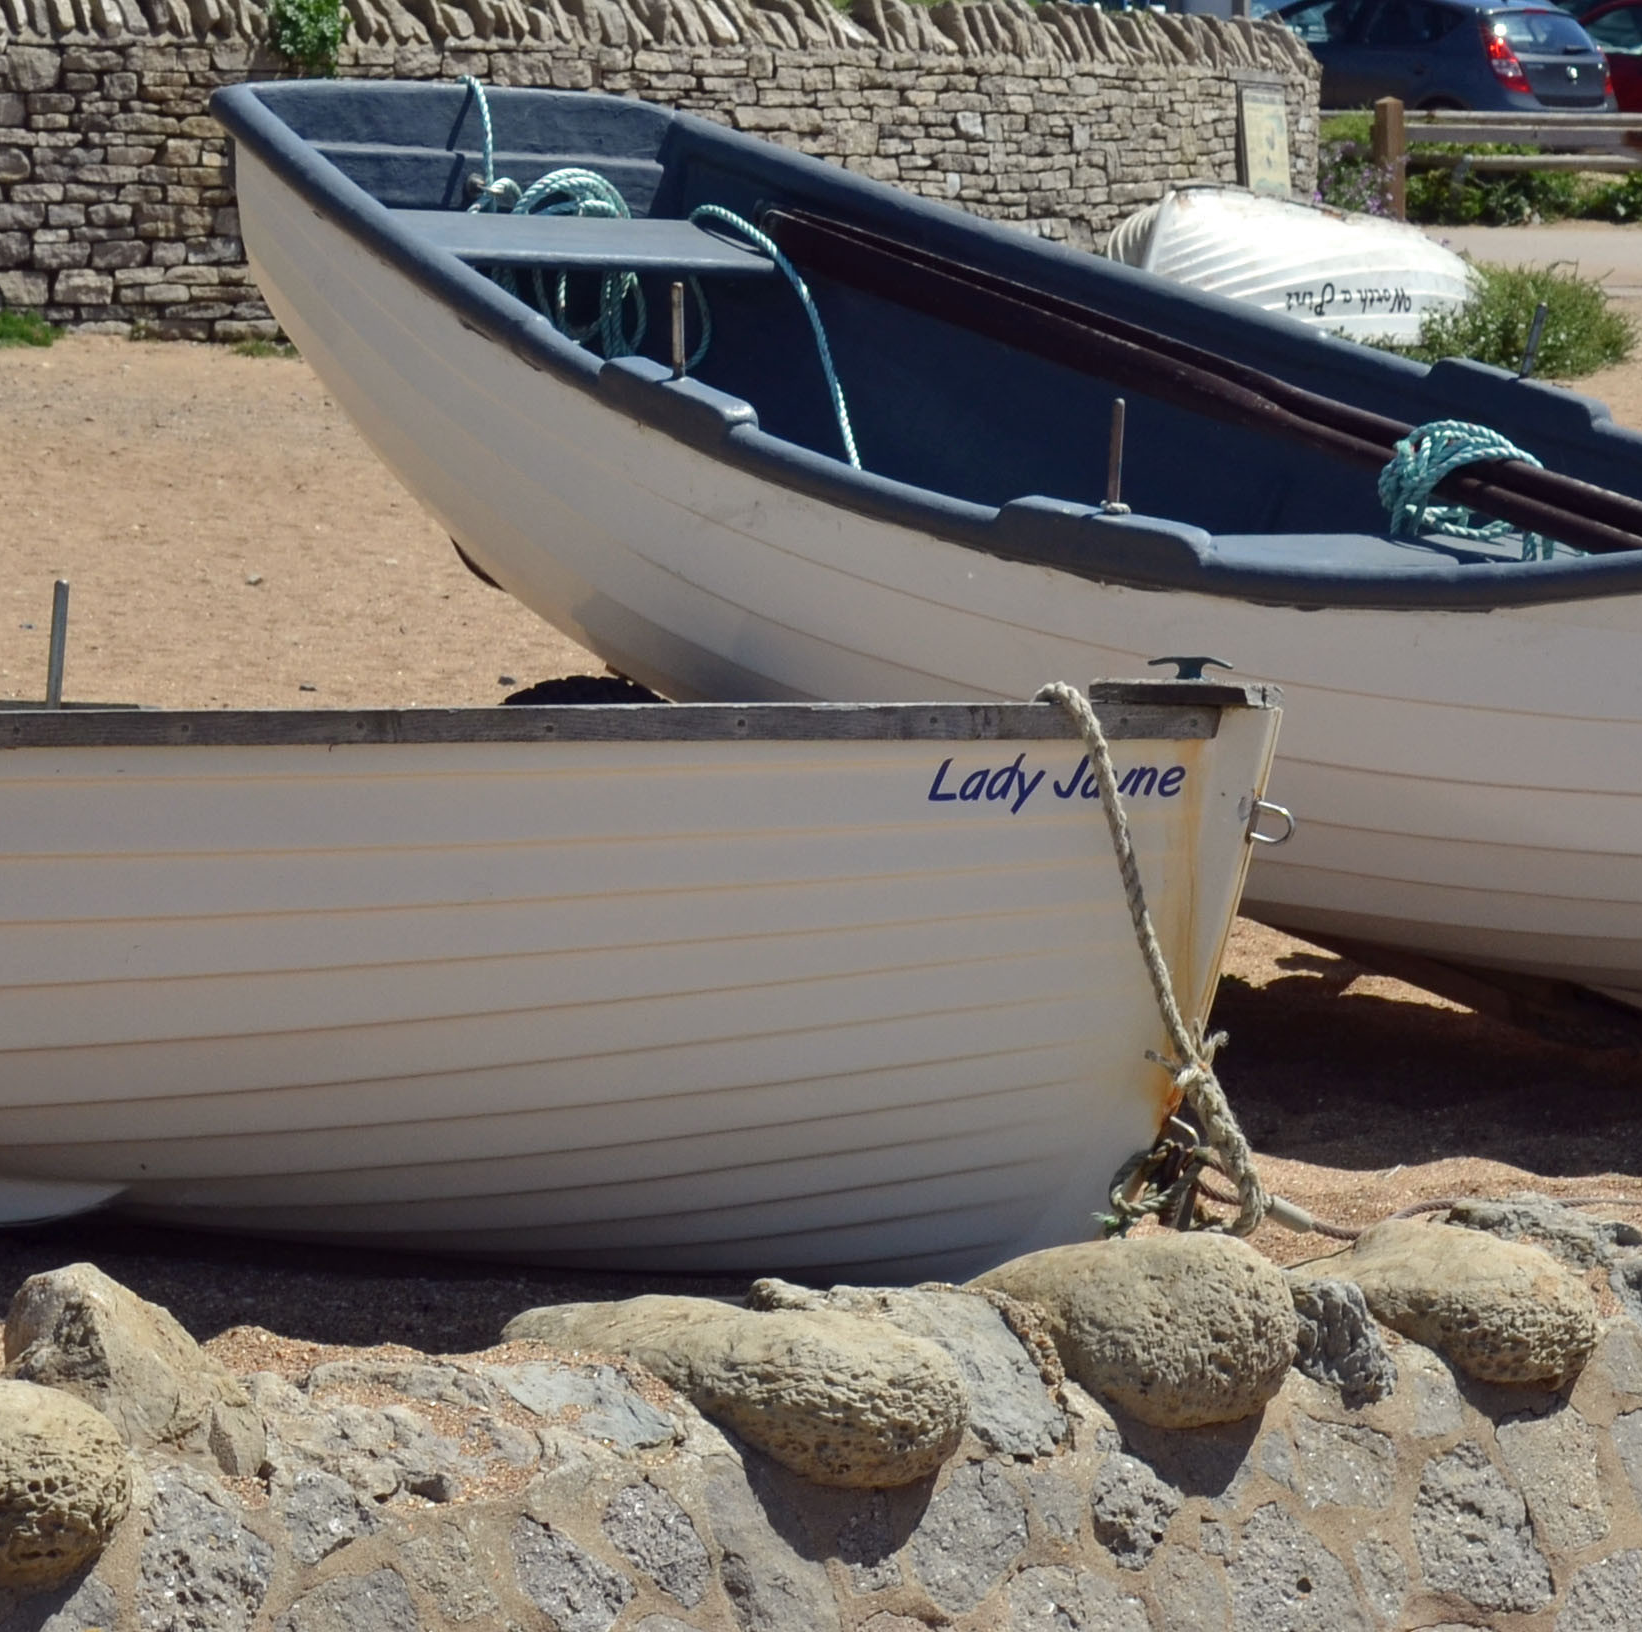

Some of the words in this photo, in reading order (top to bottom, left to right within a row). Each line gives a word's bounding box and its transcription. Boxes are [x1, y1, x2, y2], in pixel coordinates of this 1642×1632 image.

[1340, 289, 1353, 304] a
[1356, 287, 1412, 313] Worth
[928, 753, 1046, 815] Lady
